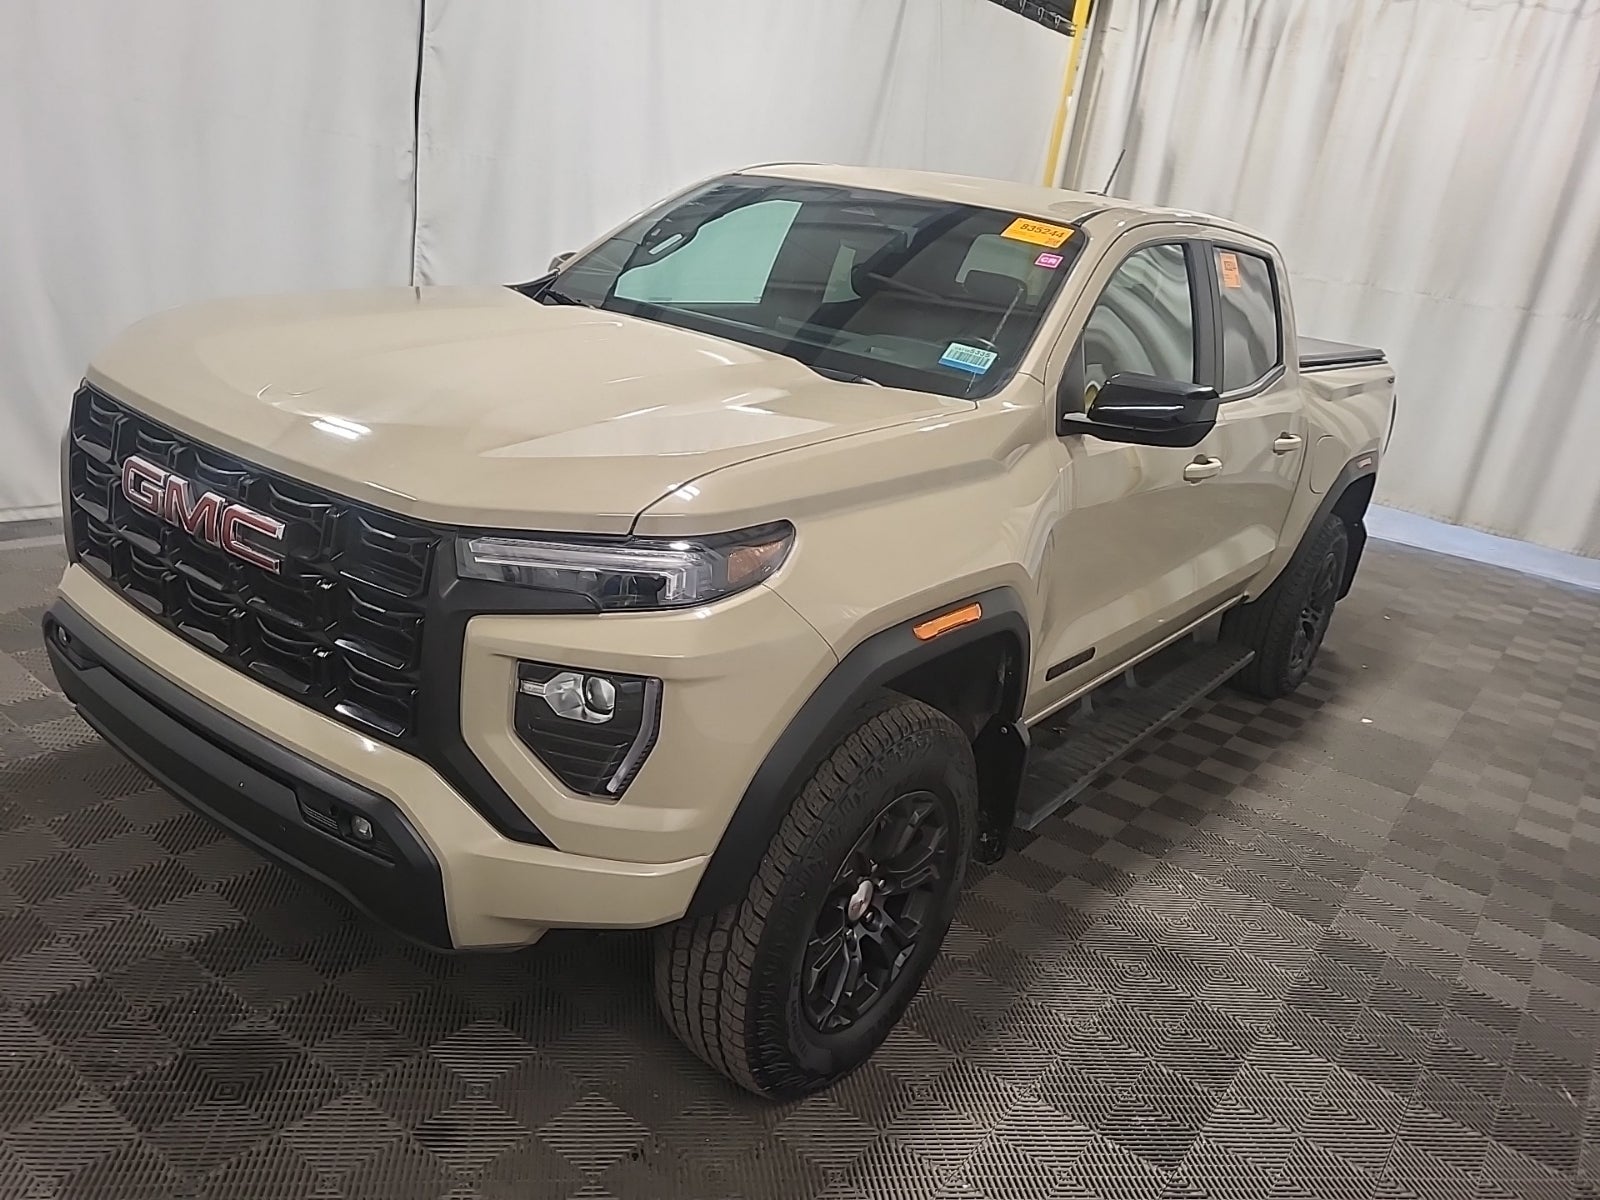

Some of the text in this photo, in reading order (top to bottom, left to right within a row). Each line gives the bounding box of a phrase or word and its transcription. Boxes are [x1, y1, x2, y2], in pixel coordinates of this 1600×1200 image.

[1020, 223, 1065, 238] 835244
[970, 348, 991, 358] 5335
[121, 455, 286, 575] GMC
